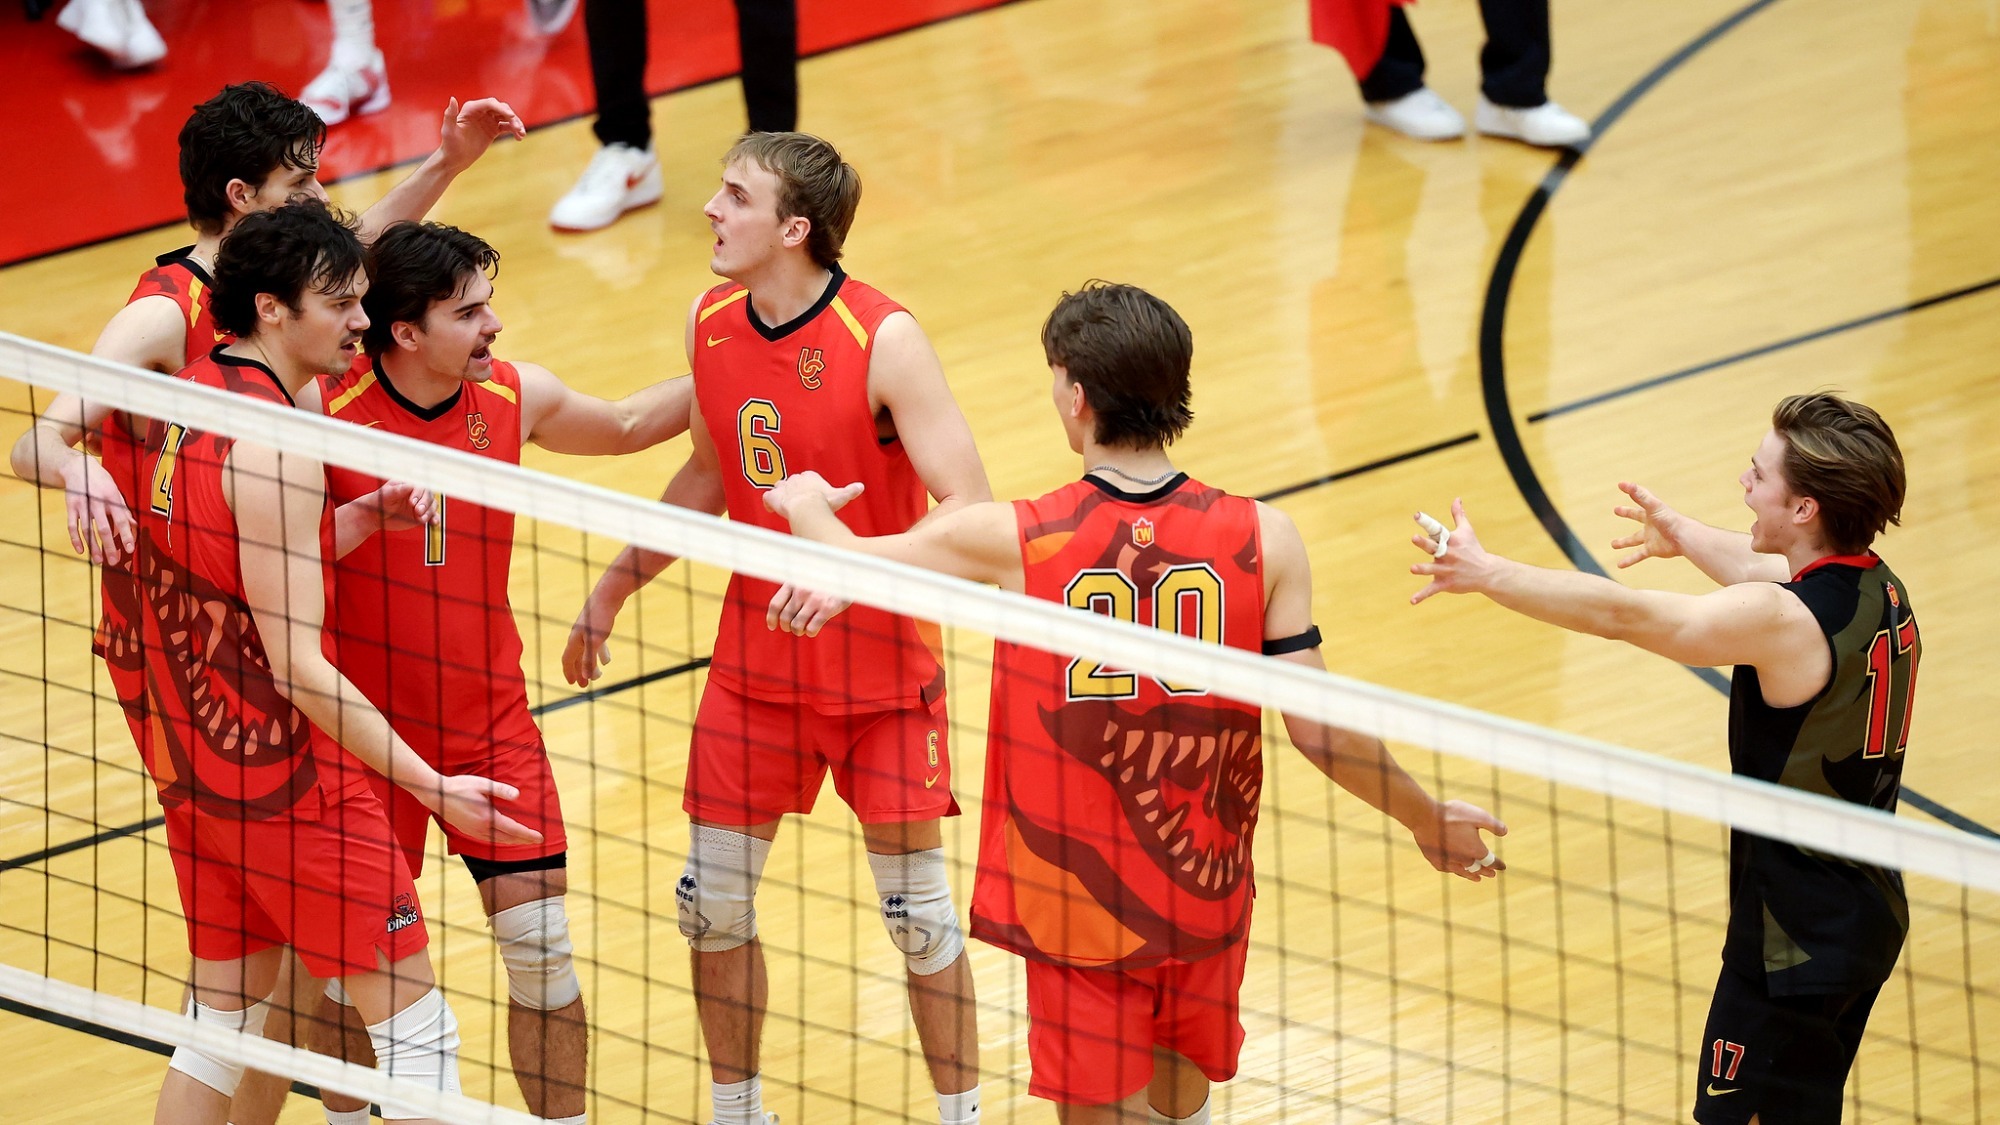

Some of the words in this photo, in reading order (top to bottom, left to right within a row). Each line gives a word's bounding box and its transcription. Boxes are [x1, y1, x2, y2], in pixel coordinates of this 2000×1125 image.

[737, 398, 788, 488] 6
[1134, 527, 1151, 542] CW
[1063, 562, 1224, 702] 20
[1862, 614, 1917, 759] 17
[927, 730, 939, 768] 6
[386, 911, 418, 933] DINOS
[1712, 1038, 1745, 1081] 17
